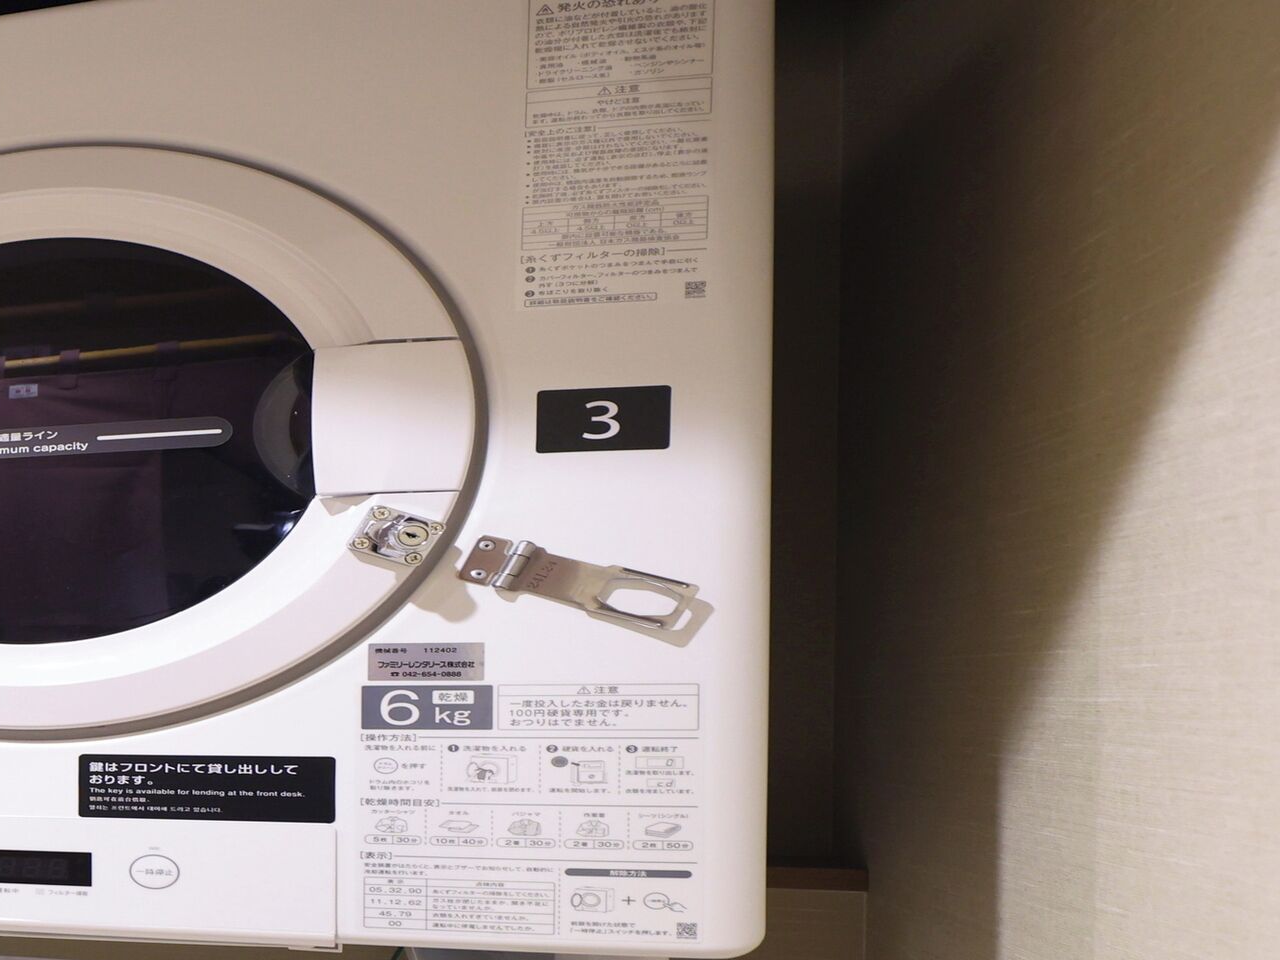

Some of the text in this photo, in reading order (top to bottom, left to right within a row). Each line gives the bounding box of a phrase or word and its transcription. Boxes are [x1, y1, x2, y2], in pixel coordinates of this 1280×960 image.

[614, 84, 640, 94] 注意
[582, 400, 621, 439] 3
[33, 441, 88, 453] capacity
[594, 686, 619, 694] 注意
[438, 692, 468, 702] 乾燥
[380, 689, 471, 726] 6 kg
[510, 699, 687, 708] 一度投入したお金は戻りません。
[510, 709, 629, 717] 100円硬貨専用です。
[510, 719, 618, 727] おつりはでません。
[89, 762, 299, 775] 鍵はフロントにて貸し出しして
[89, 775, 154, 785] おります。
[108, 788, 124, 796] key
